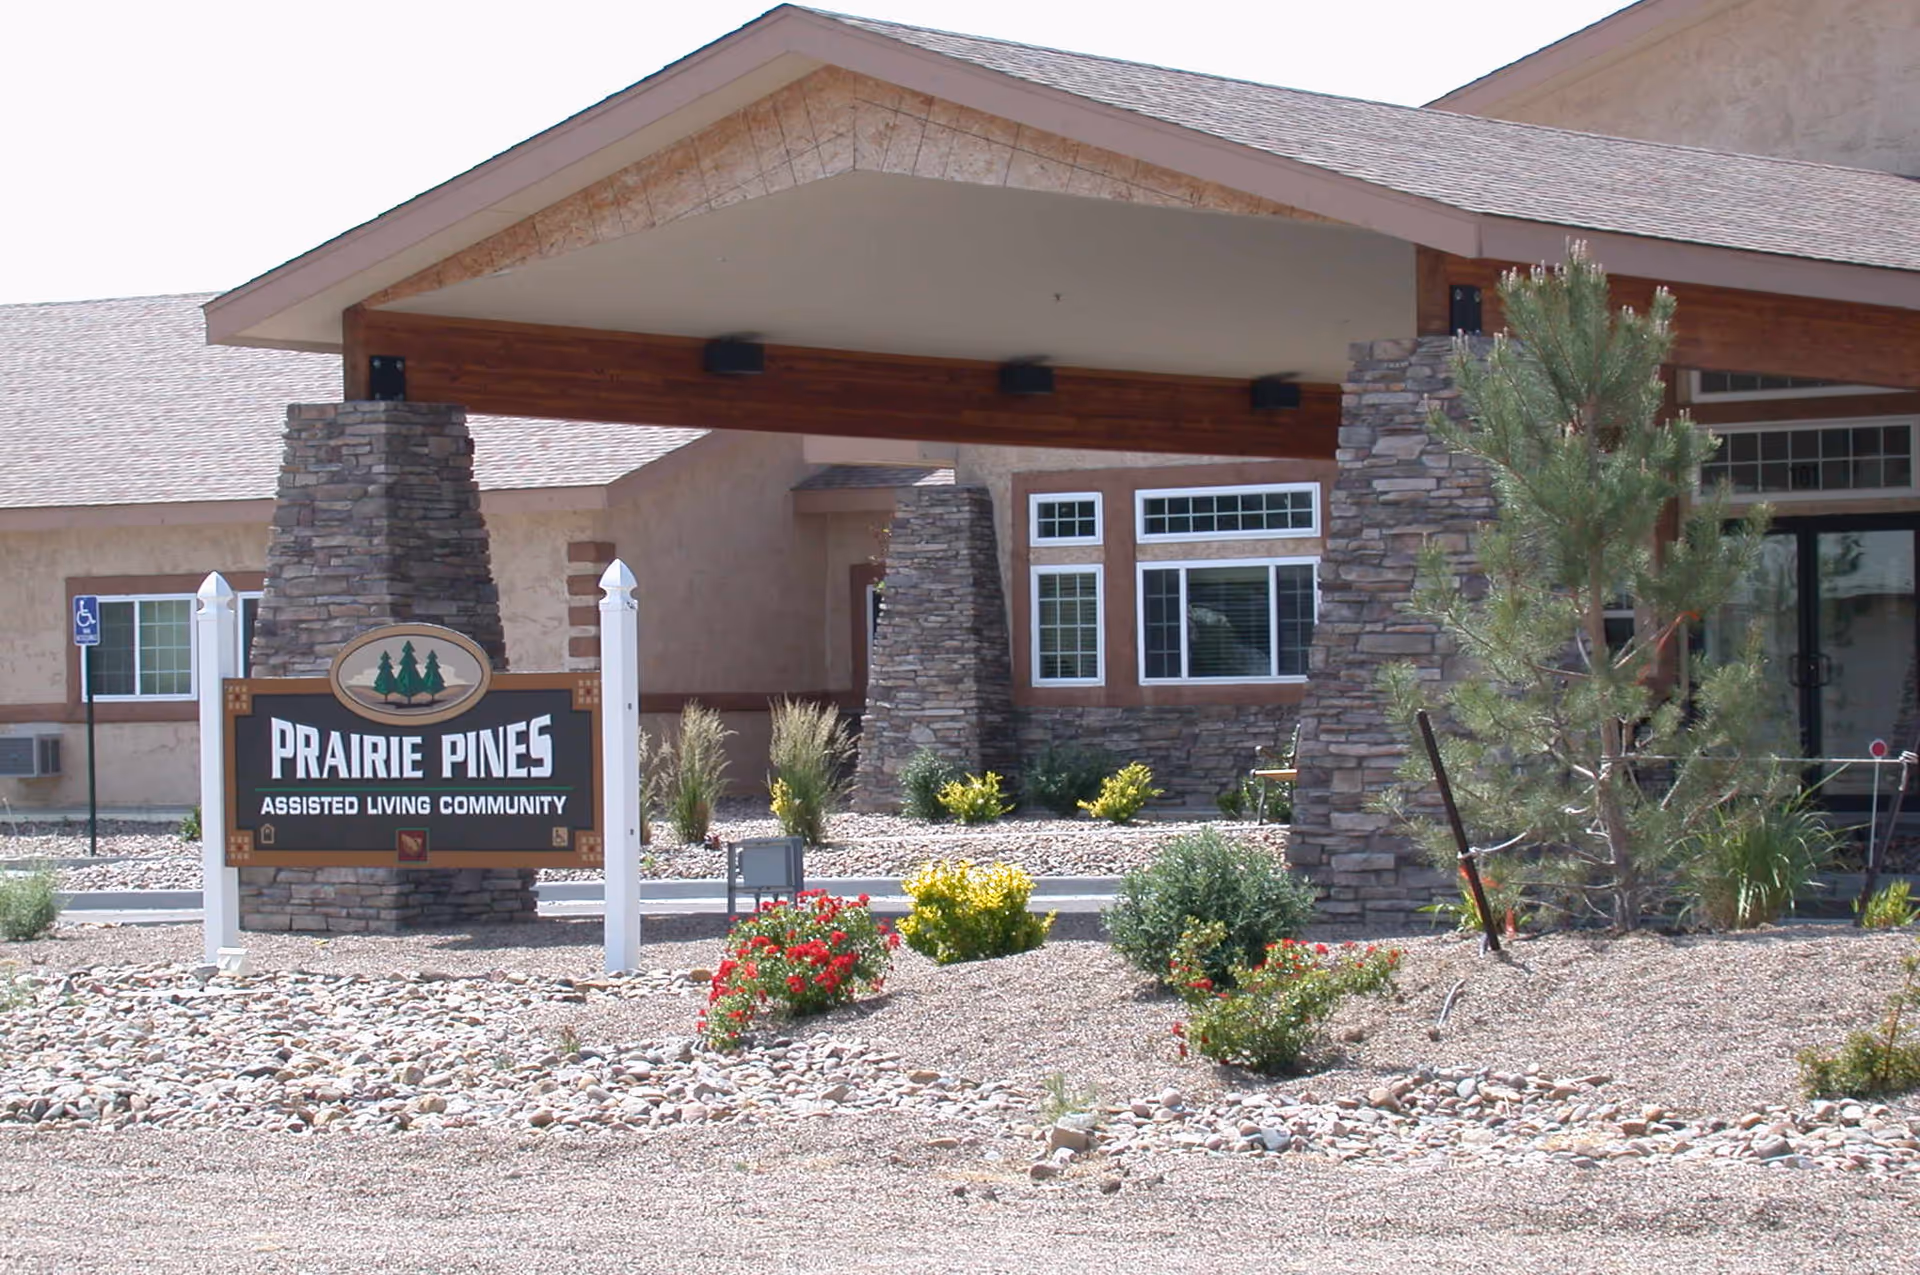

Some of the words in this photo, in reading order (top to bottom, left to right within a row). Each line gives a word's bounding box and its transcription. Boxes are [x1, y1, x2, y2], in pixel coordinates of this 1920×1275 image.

[271, 716, 424, 780] PRAIRIE
[440, 714, 553, 779] PINES
[260, 796, 359, 816] ASSISTED
[367, 796, 431, 815] LIVING
[439, 795, 567, 815] COMMUNITY
